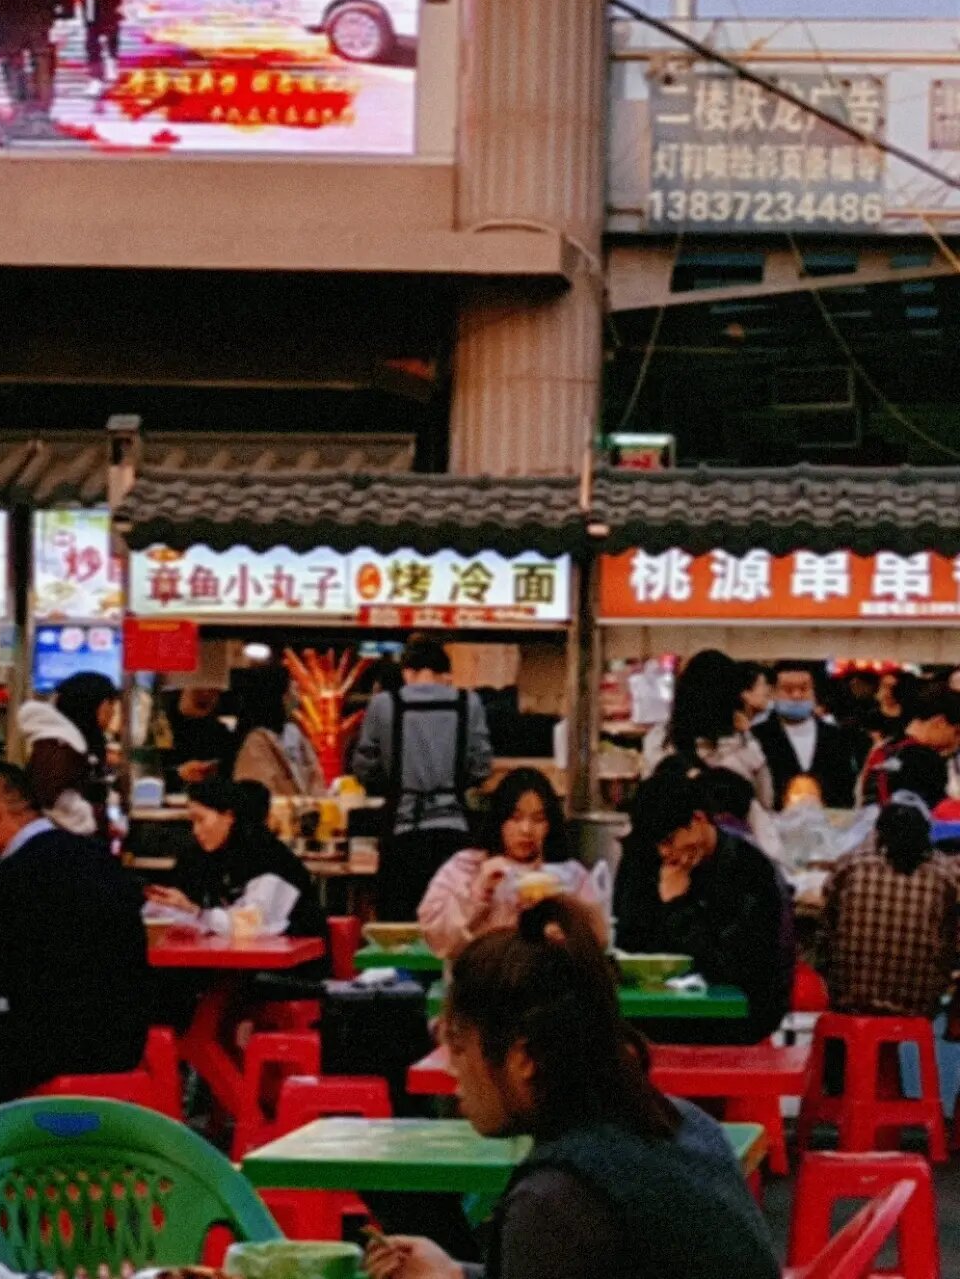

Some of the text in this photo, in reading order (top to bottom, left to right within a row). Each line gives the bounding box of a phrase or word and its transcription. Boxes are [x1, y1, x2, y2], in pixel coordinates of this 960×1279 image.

[648, 189, 882, 222] 13837234486
[146, 561, 342, 608] 章鱼小丸子
[386, 559, 558, 605] 烤冷面
[628, 546, 960, 603] 桃源串串
